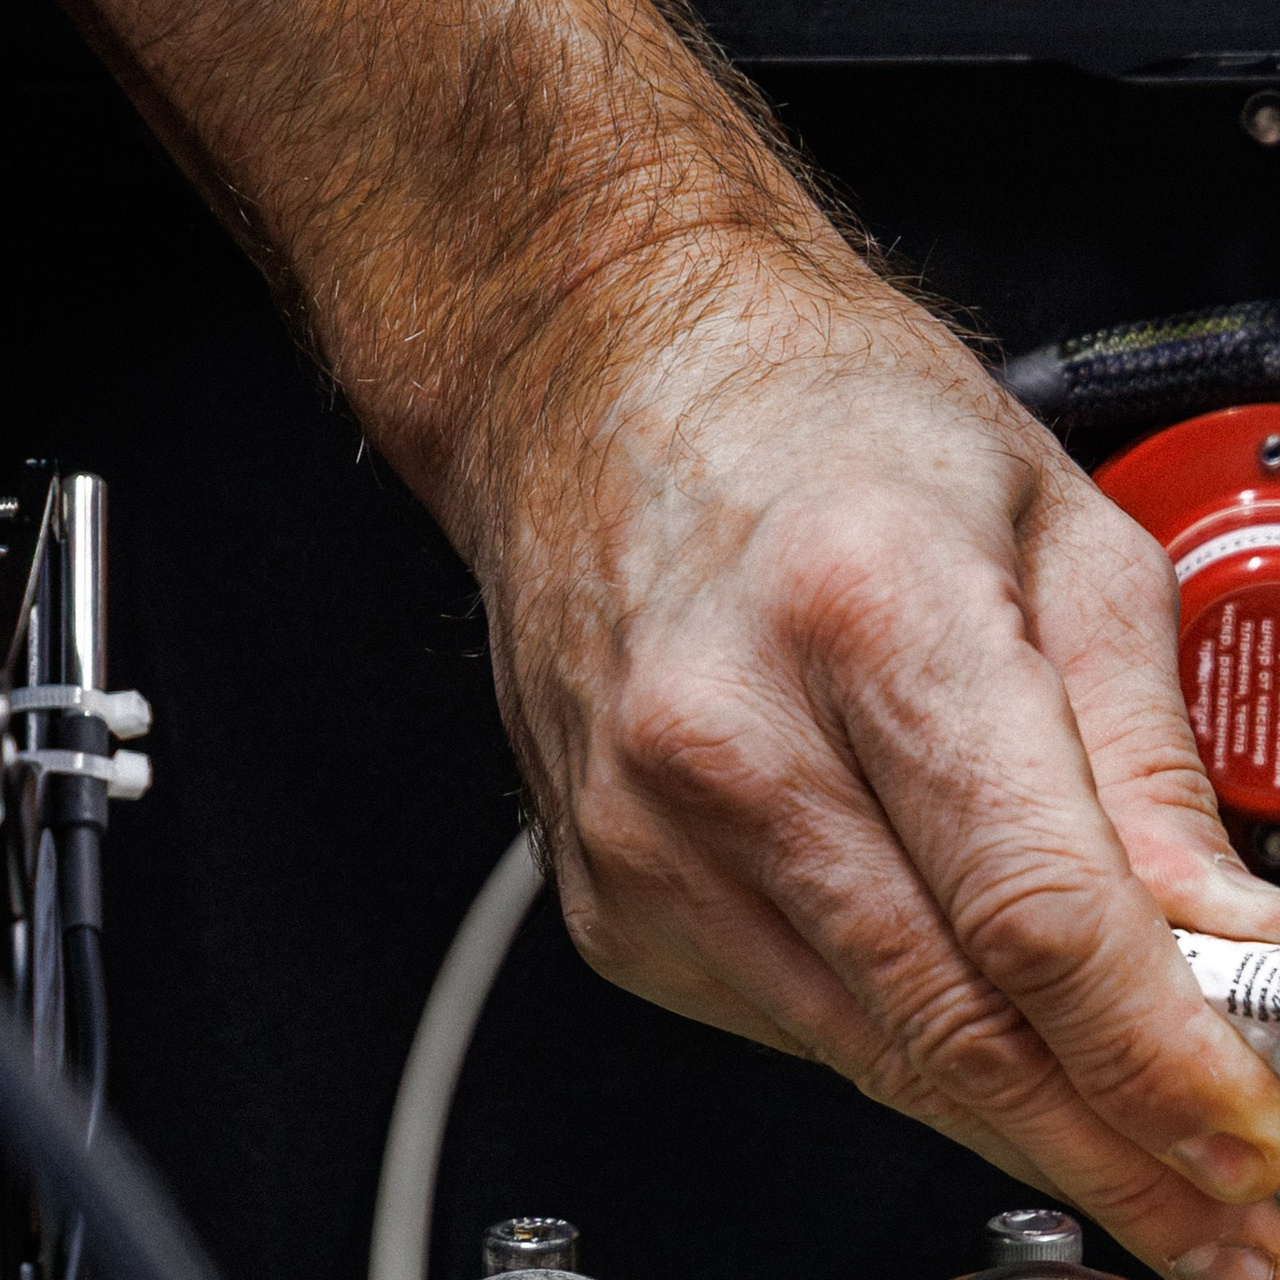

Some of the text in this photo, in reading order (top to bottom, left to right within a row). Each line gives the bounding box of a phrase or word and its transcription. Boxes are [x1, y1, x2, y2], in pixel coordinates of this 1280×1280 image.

[1257, 620, 1273, 666] шнур
[1258, 671, 1272, 691] от
[1213, 656, 1230, 769] раскаленных
[1233, 704, 1249, 755] тепла
